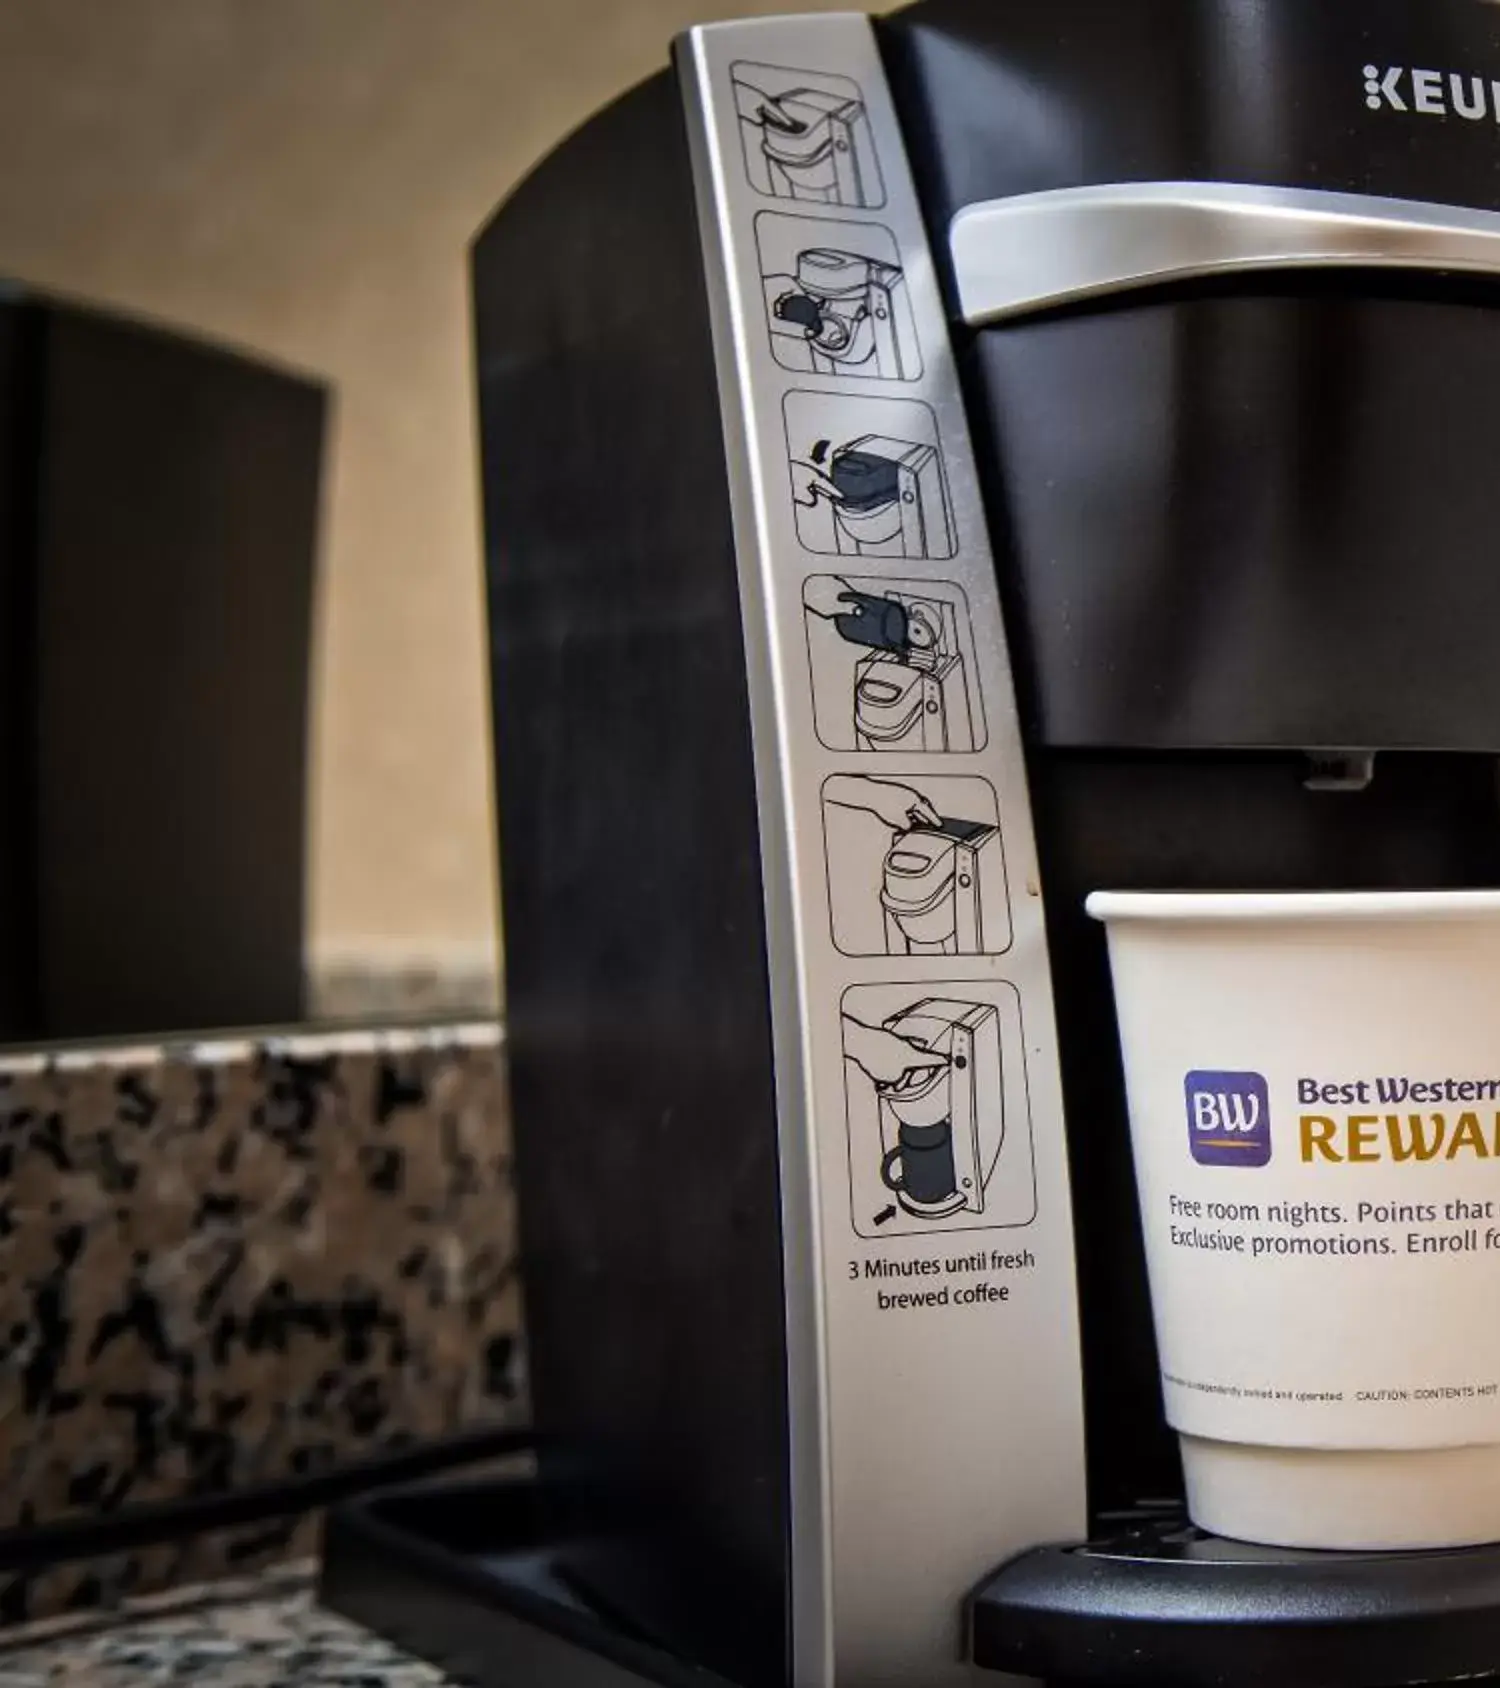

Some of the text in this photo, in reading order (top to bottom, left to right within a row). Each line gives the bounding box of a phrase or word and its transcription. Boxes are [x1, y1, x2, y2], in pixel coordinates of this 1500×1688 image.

[1297, 1078, 1370, 1105] Best
[1193, 1092, 1259, 1132] BW
[1169, 1195, 1201, 1217] Free
[1207, 1203, 1259, 1221] room
[1268, 1202, 1348, 1227] nights.
[1358, 1202, 1436, 1223] Points
[1445, 1200, 1493, 1220] that
[1171, 1226, 1245, 1252] Exclusive
[1252, 1234, 1396, 1256] promotions.
[1407, 1230, 1477, 1253] Enroll
[848, 1250, 1035, 1280] 3 Minutes until fresh
[878, 1283, 1009, 1310] brewed coffee
[1413, 1386, 1474, 1400] CONTENTS
